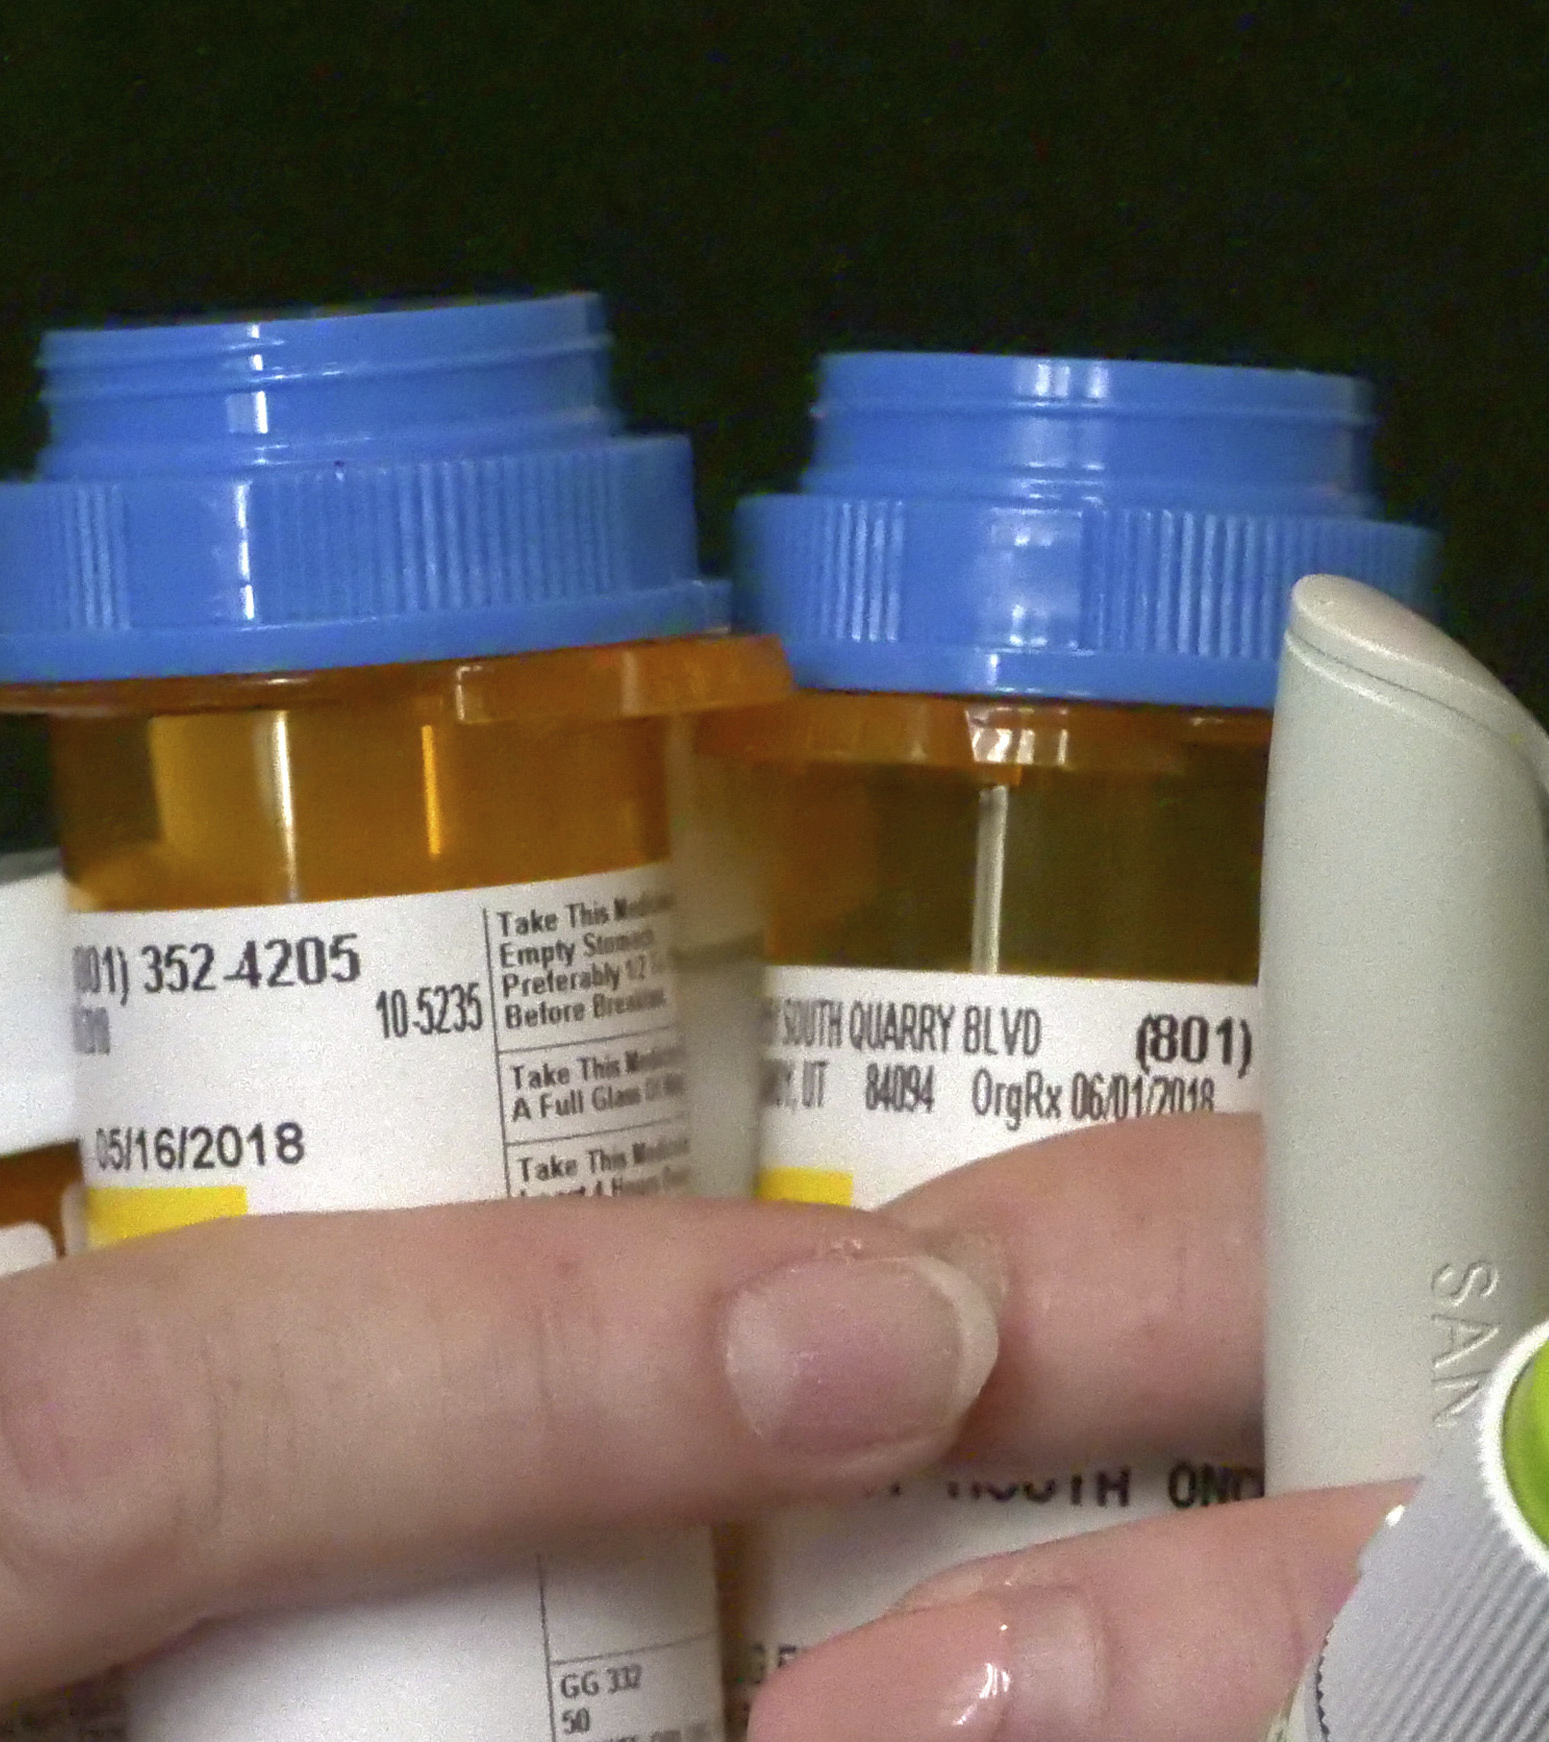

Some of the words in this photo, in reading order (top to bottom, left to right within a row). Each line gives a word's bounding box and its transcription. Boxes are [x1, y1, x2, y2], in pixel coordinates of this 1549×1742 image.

[496, 909, 558, 938] Take
[564, 901, 609, 929] This
[500, 938, 576, 970] Empty
[502, 961, 621, 999] Preferably
[376, 982, 484, 1039] 10-5235
[505, 1000, 586, 1030] Before
[850, 1000, 955, 1053] QUARRY
[962, 1004, 1042, 1057] BLVD
[1136, 1012, 1252, 1079] (801)
[512, 1063, 570, 1091] Take
[577, 1055, 620, 1082] This
[513, 1096, 531, 1122] A
[539, 1089, 584, 1119] Full
[865, 1063, 936, 1113] 84094
[972, 1067, 1063, 1132] OrgRx
[1071, 1071, 1216, 1121] 06/01/2018
[96, 1121, 306, 1172] 05/16/2018
[517, 1155, 577, 1183] Take
[560, 1671, 600, 1699] GG
